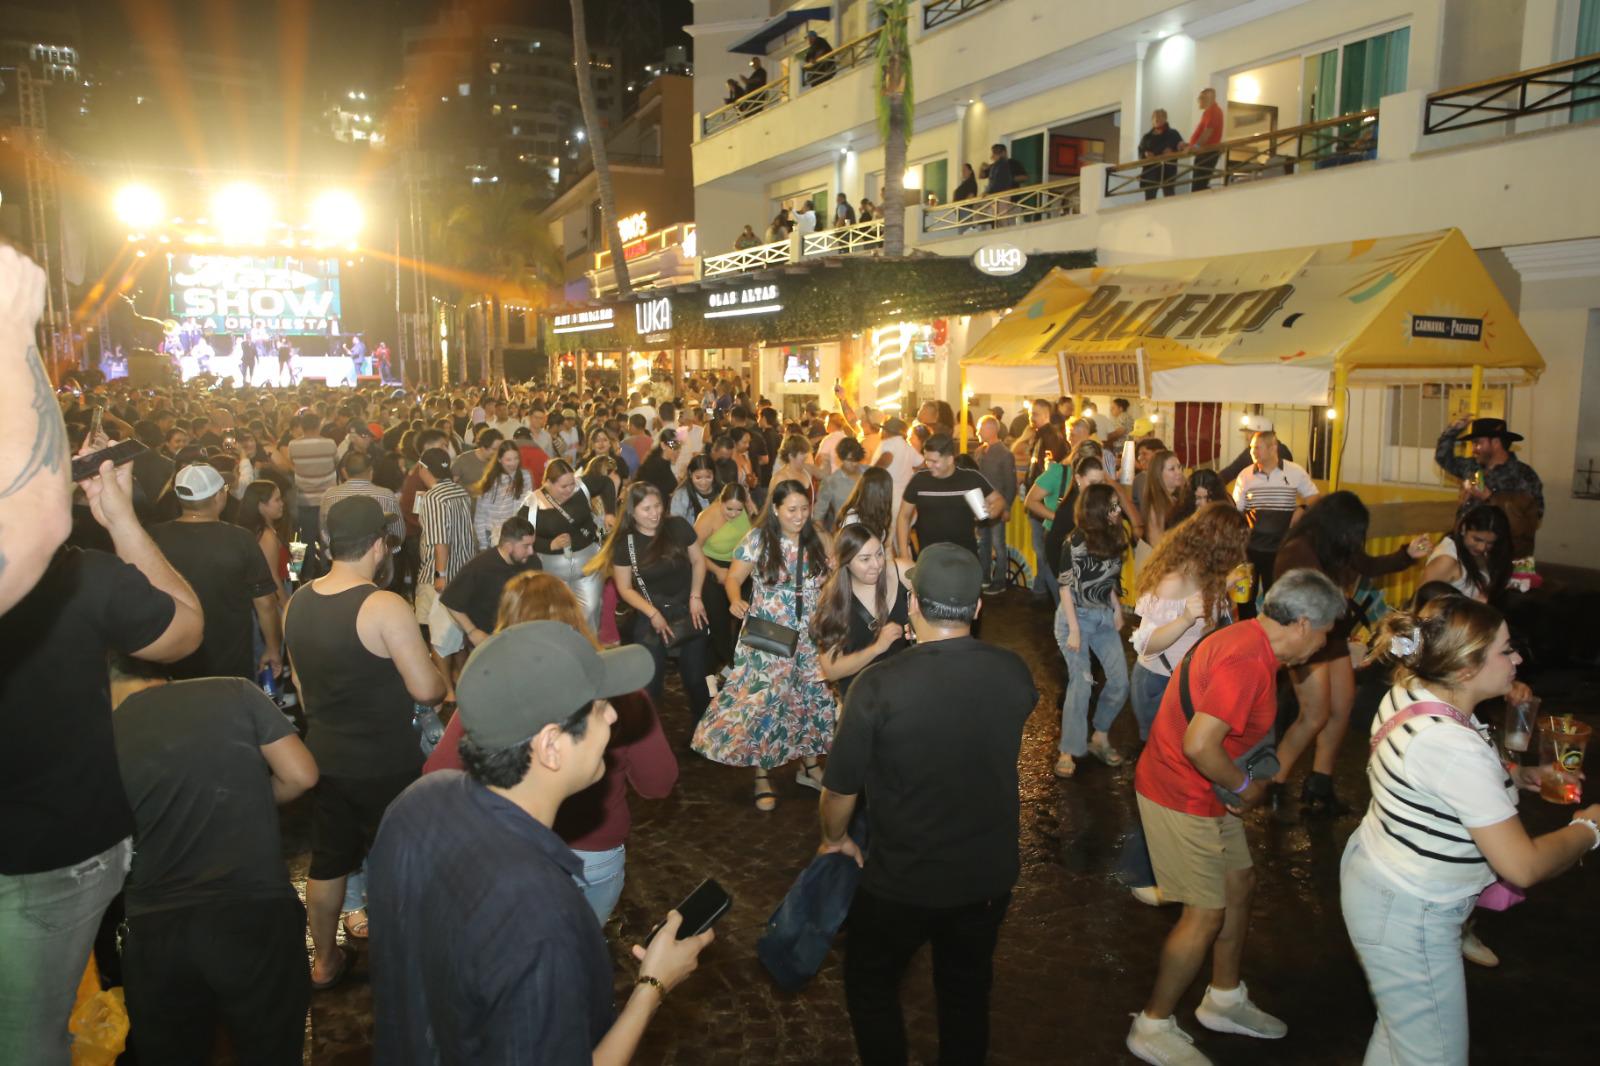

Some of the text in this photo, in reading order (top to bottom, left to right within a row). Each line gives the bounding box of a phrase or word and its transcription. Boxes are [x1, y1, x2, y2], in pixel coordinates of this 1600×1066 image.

[980, 248, 1021, 267] LUKA
[184, 288, 333, 317] SHOW
[708, 285, 777, 307] OLAS ALTAS
[635, 297, 671, 335] LUKA
[1037, 283, 1297, 353] PACIFICO
[1415, 319, 1479, 336] CARNAVAL PACIFICO
[1067, 356, 1137, 394] PACIFICO
